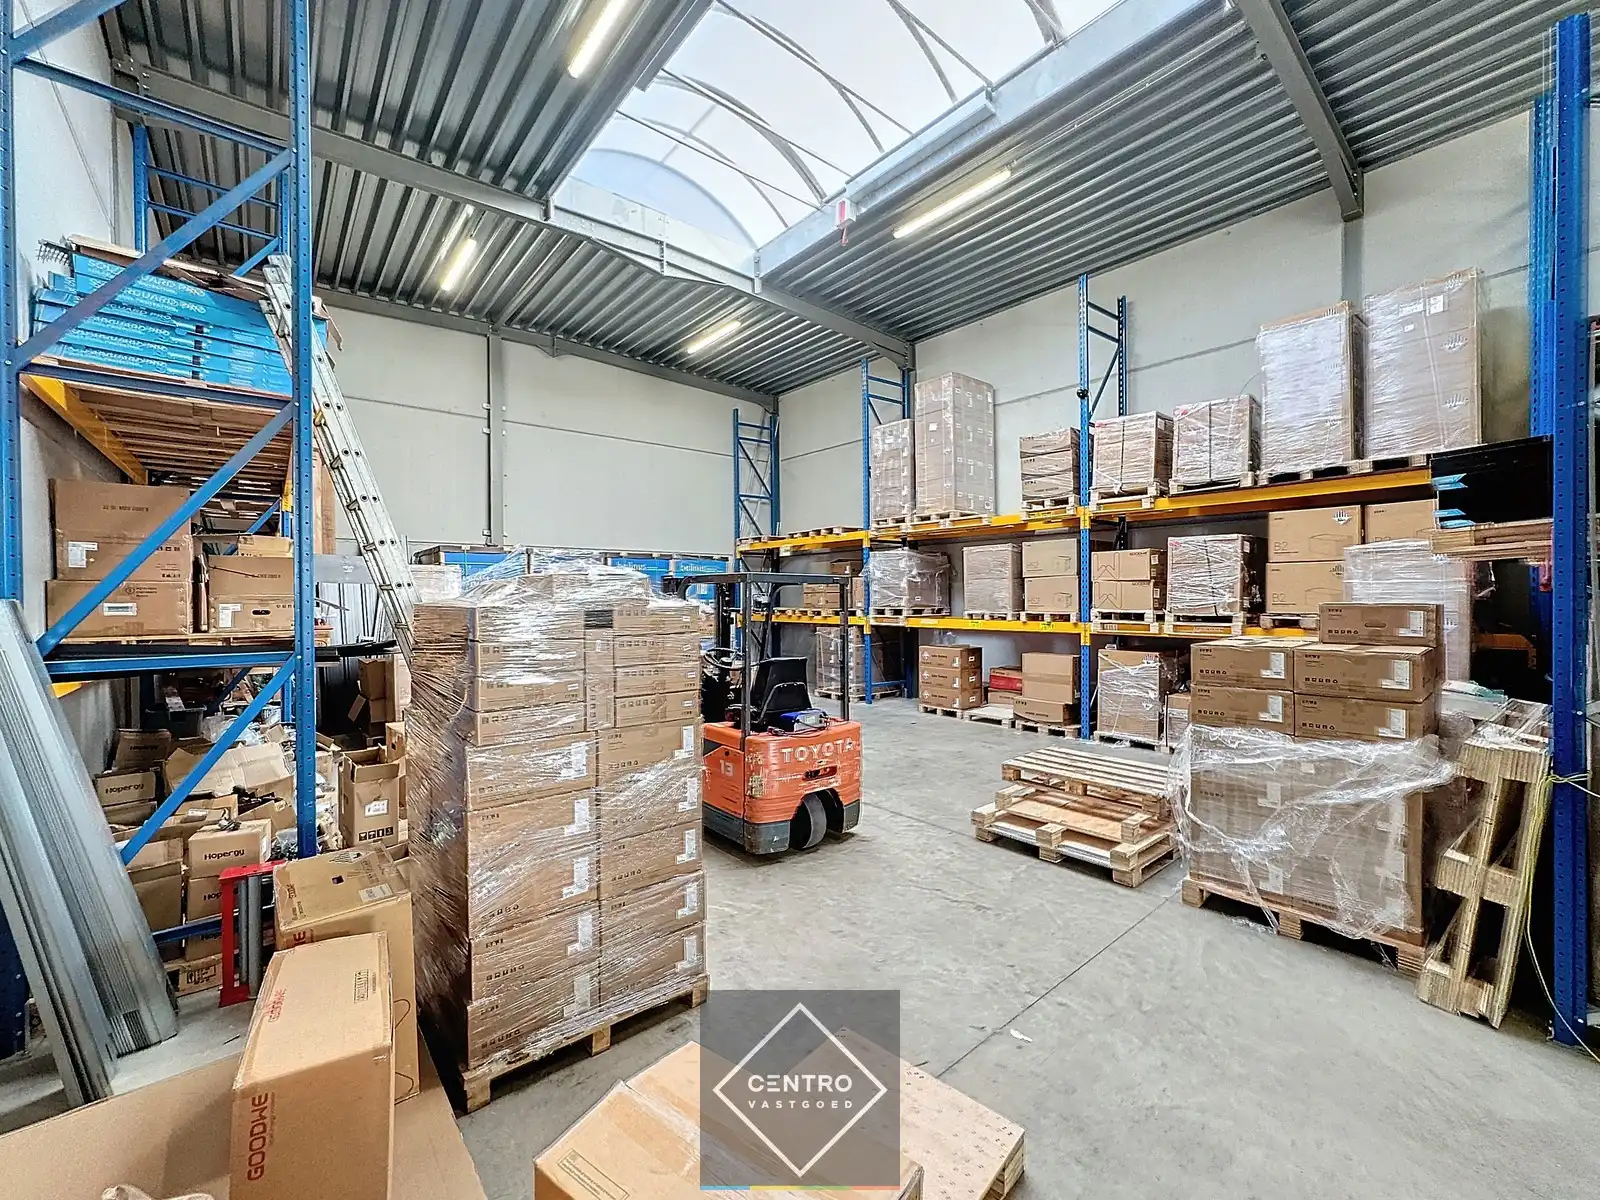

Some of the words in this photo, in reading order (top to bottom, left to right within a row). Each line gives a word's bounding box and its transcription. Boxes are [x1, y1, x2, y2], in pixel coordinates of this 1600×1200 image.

[1273, 541, 1289, 551] B2
[1272, 593, 1286, 602] B2
[781, 737, 856, 763] TOYOTA
[719, 760, 734, 777] 13
[105, 783, 145, 794] Hopergy
[204, 849, 245, 861] Hopergy
[247, 1092, 269, 1181] GOODWE
